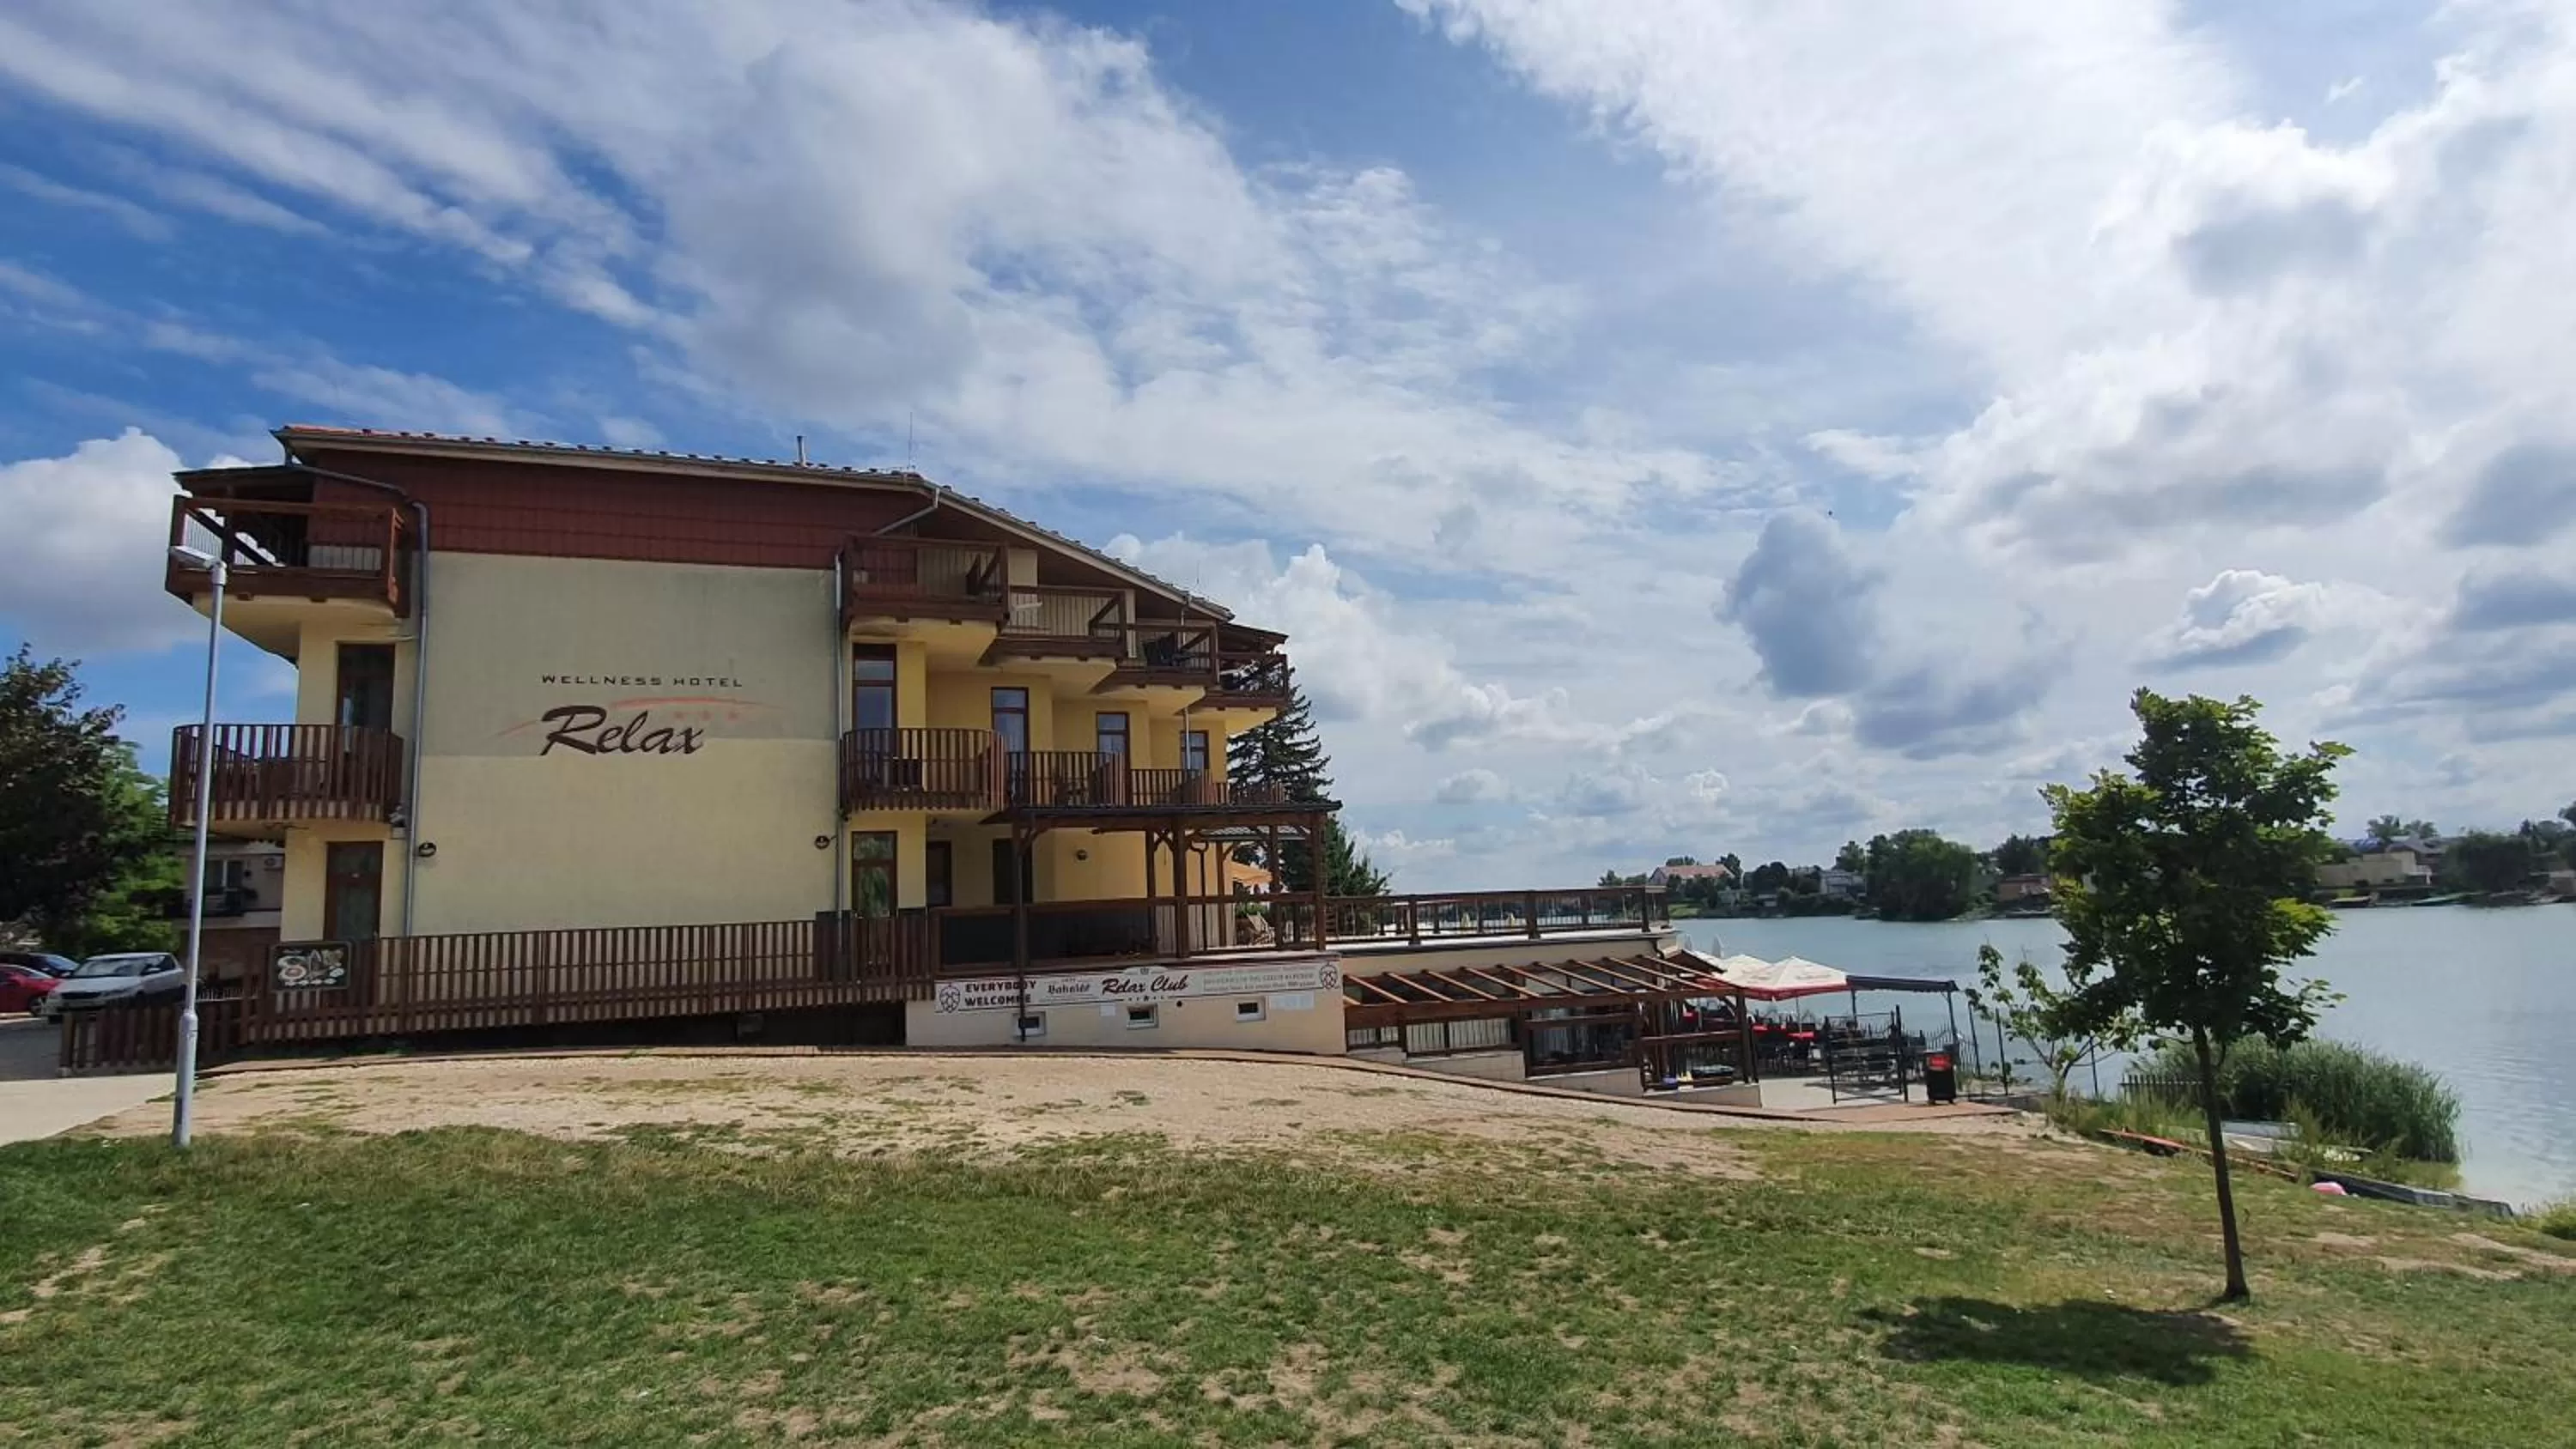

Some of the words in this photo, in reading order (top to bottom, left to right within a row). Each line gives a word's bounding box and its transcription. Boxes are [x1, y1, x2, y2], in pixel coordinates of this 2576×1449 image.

[541, 674, 663, 686] WELLNESS
[672, 676, 744, 688] HOTEL
[539, 704, 705, 756] Relax
[964, 979, 1037, 993] EVERYBODY
[1101, 977, 1146, 996] Relax
[1151, 974, 1189, 993] Club
